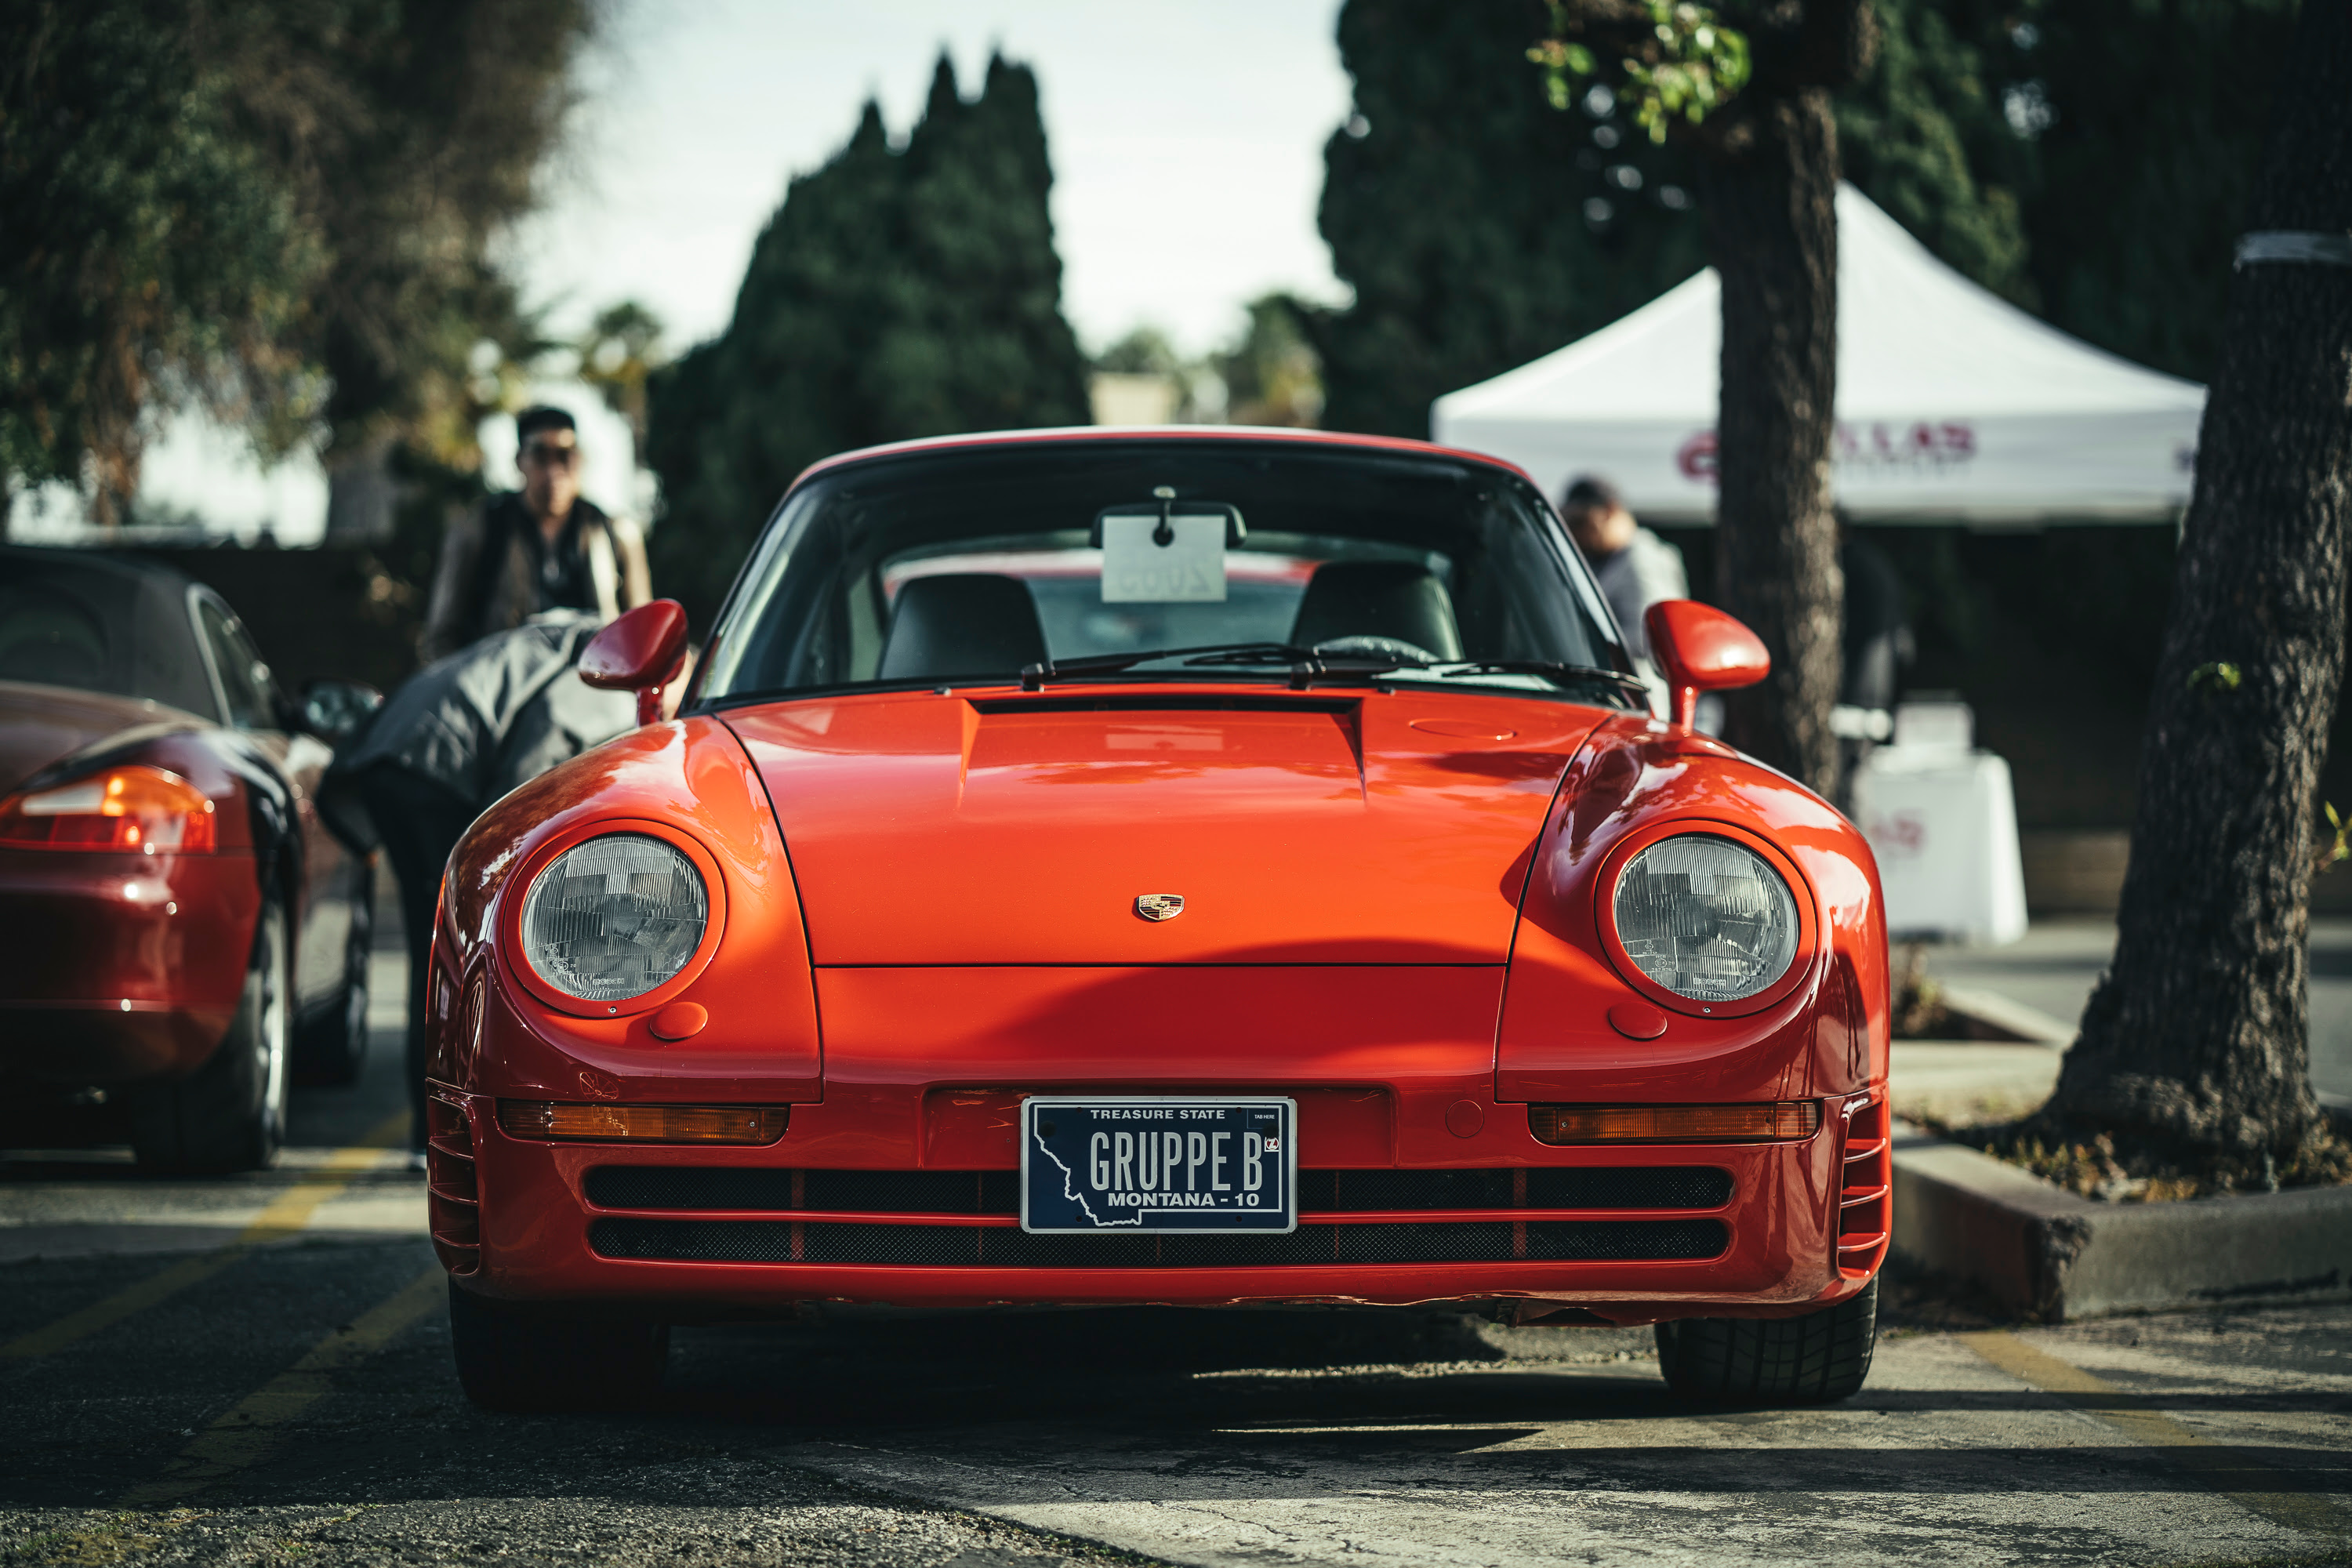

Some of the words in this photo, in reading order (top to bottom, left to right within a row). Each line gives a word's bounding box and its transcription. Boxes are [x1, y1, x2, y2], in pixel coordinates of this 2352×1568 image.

[1693, 977, 1726, 986] BOSCH
[1091, 1110, 1174, 1119] TREASURE
[1180, 1110, 1225, 1119] STATE
[1091, 1132, 1230, 1190] GRUPPE
[1244, 1132, 1262, 1190] B
[1109, 1193, 1215, 1206] MONTANA
[1235, 1193, 1259, 1206] 10
